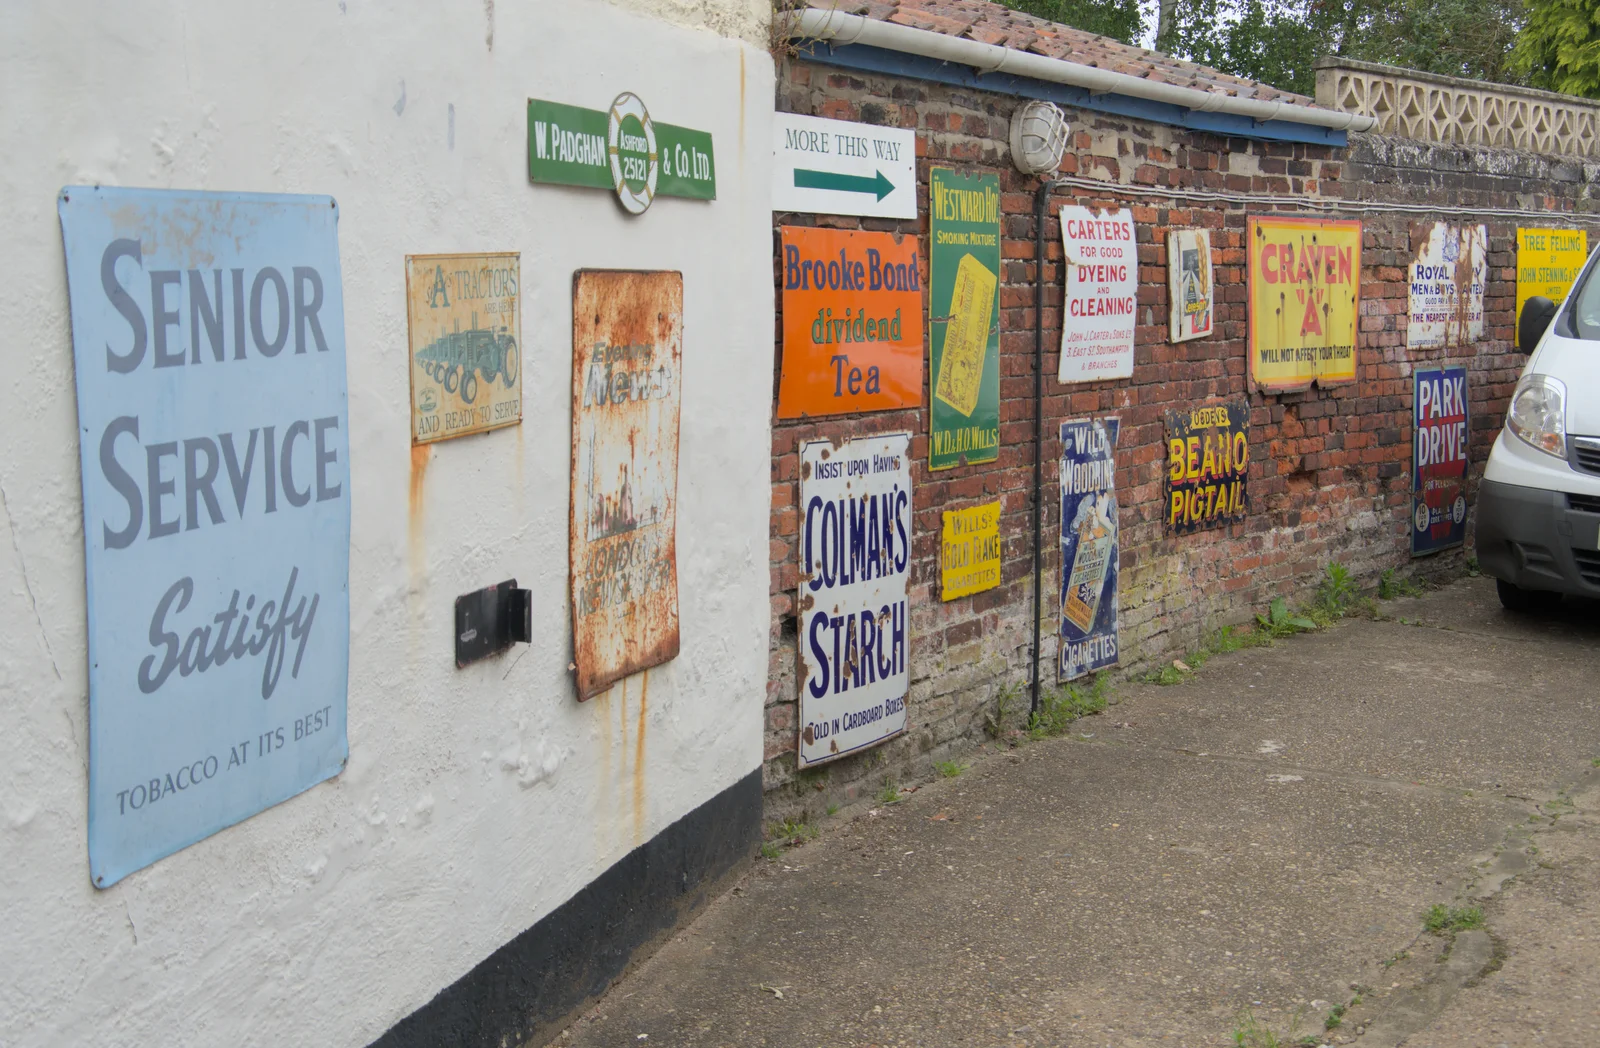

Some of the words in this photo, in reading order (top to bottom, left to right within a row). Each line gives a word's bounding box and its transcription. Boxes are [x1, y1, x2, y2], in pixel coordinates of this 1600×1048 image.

[620, 130, 647, 153] ASHFORD
[785, 128, 829, 153] MORE
[835, 134, 868, 158] THIS
[873, 139, 901, 161] WAY
[624, 157, 646, 181] 25121
[663, 148, 671, 175] &
[937, 230, 968, 244] SMOKING
[970, 232, 996, 246] MIXTURE
[1068, 220, 1130, 241] CARTERS
[1524, 235, 1546, 251] TREE
[1551, 236, 1580, 252] FELLING
[1080, 246, 1096, 258] FOR
[1100, 247, 1123, 258] GOOD
[1260, 243, 1352, 287] CRAVEN
[1550, 255, 1556, 263] BY
[785, 244, 865, 291] Brooke
[867, 248, 920, 292] Bond
[1078, 265, 1126, 282] DYEING
[1416, 264, 1450, 280] ROYAL
[1519, 268, 1536, 283] JOHN
[1538, 268, 1568, 283] STENNING
[430, 264, 451, 308] A
[454, 268, 518, 300] TRACTORS
[1412, 283, 1428, 295] MEN
[1435, 284, 1454, 295] BYS
[101, 238, 329, 374] SENIOR
[484, 303, 498, 314] ARE
[1070, 297, 1132, 317] CLEANING
[1412, 312, 1424, 322] THE
[812, 308, 902, 344] dividend
[1068, 332, 1082, 342] JOHN
[1090, 330, 1108, 340] CARTER
[1113, 329, 1124, 340] SONS
[592, 341, 651, 366] Evening
[1072, 346, 1086, 357] EAST
[1088, 360, 1118, 370] BRANCHES
[1260, 349, 1279, 364] WILL
[1280, 348, 1294, 362] NOT
[1296, 348, 1317, 362] AFFECT
[1318, 346, 1332, 360] YOUR
[1332, 345, 1351, 360] THROAT
[584, 362, 672, 408] News
[830, 354, 880, 397] Tea
[1420, 376, 1464, 420] PARK
[418, 415, 440, 435] AND
[446, 408, 476, 430] READY
[480, 405, 492, 423] TO
[494, 400, 518, 420] SERVE
[1418, 422, 1466, 466] DRIVE
[816, 460, 843, 480] INSIST
[848, 458, 869, 476] UPON
[1170, 432, 1247, 485] BEANO
[100, 415, 342, 550] SERVICE
[1171, 481, 1244, 525] PIGTAIL
[805, 483, 908, 592] COLMAN'S
[943, 542, 970, 571] GOLD
[973, 534, 999, 565] FLAKE
[948, 568, 996, 592] CIGARETTES
[138, 566, 320, 700] Satisfy
[809, 600, 904, 698] STARCH
[1062, 634, 1116, 671] CIGARETTES
[832, 718, 840, 736] IN
[843, 704, 883, 732] CARDBOARD
[886, 696, 904, 717] BOXES
[116, 756, 218, 816] TOBACCO
[227, 740, 250, 771] AT
[258, 728, 284, 757] ITS
[294, 706, 332, 743] BEST
